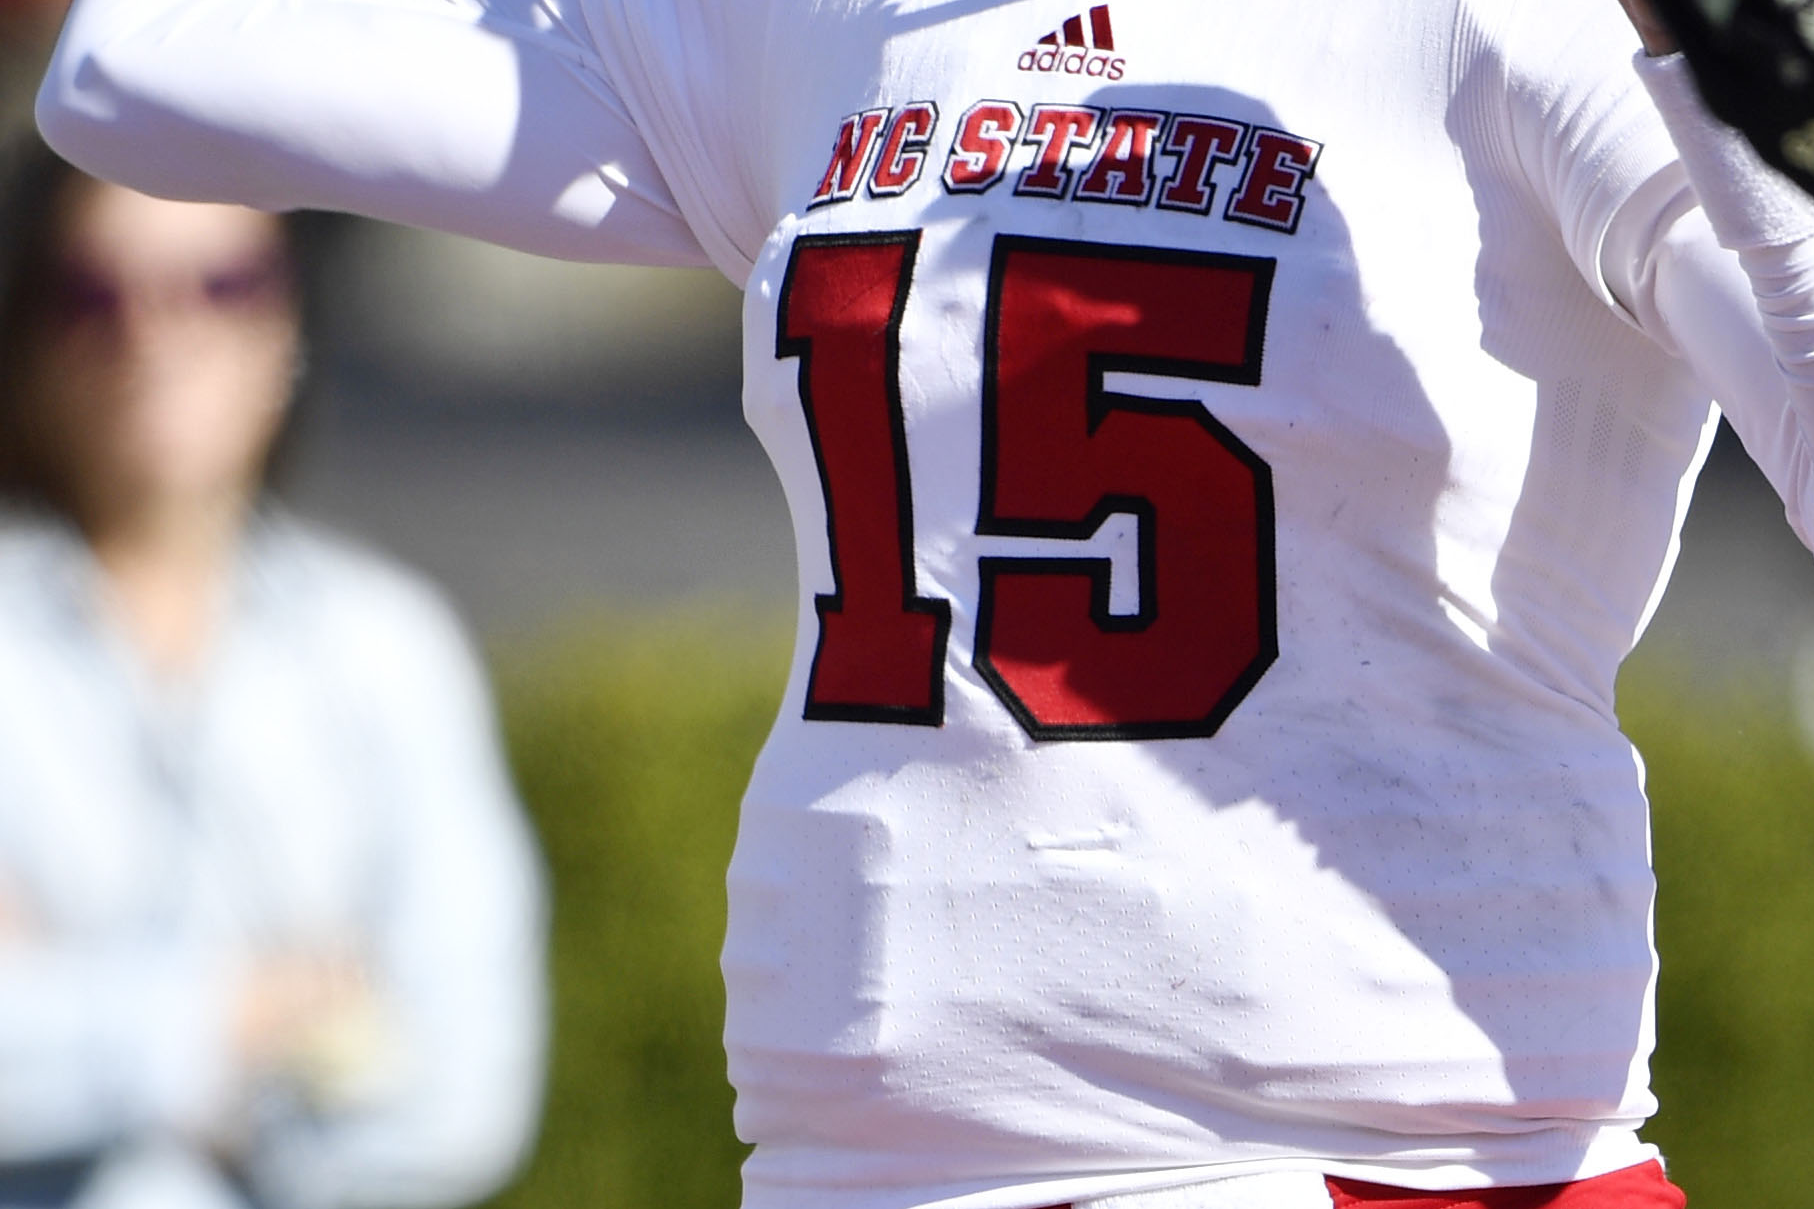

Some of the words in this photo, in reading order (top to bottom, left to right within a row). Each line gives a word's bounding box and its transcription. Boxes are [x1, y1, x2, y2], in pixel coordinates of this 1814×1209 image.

[1017, 42, 1126, 81] adidas
[806, 99, 939, 212] NC
[941, 98, 1325, 235] STATE
[775, 229, 1279, 742] 15
